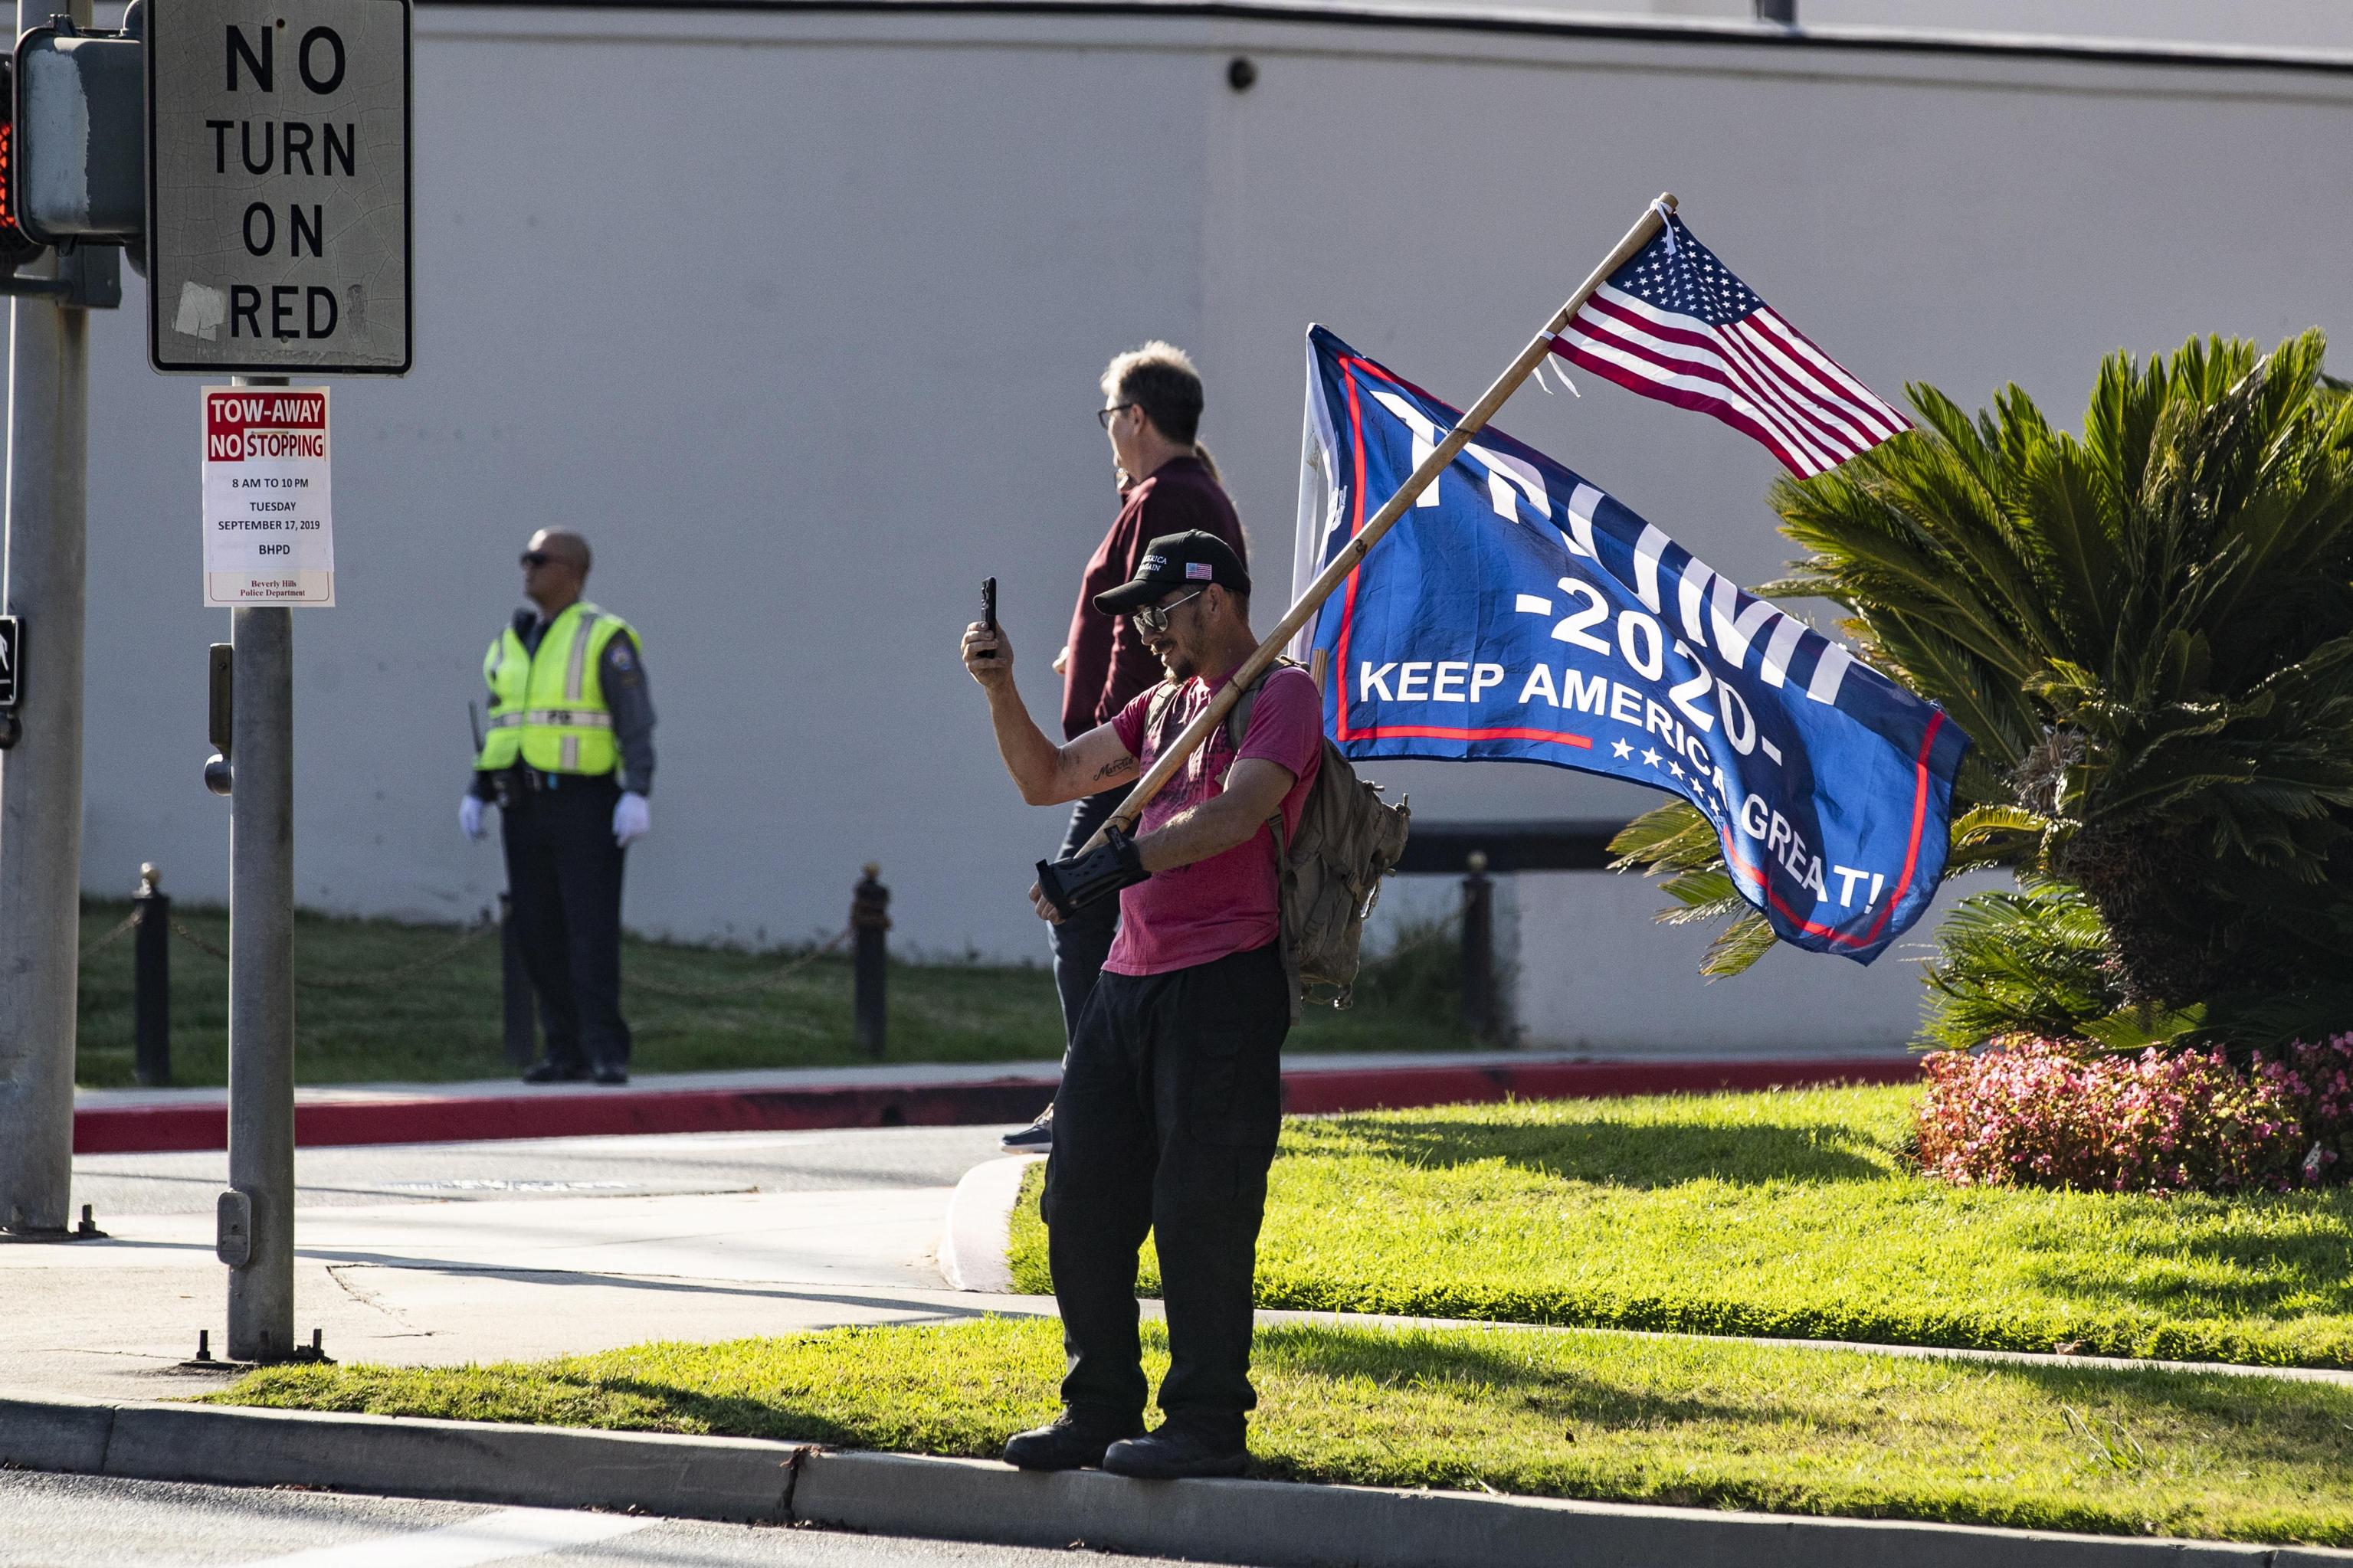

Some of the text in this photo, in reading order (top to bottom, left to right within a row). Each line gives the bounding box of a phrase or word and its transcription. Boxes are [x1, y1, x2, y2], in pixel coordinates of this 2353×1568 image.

[226, 25, 346, 95] NO
[205, 119, 356, 177] TURN
[242, 201, 323, 257] ON
[231, 285, 339, 339] RED
[211, 399, 323, 423] TOW-AWAY
[211, 434, 323, 457] NO STOPPING
[232, 478, 309, 488] 8 AM TO 10 PM
[250, 502, 297, 512] TUESDAY
[218, 520, 320, 532] SEPTEMBER 17, 2019
[258, 545, 290, 555] BHPD
[1369, 389, 1853, 706] TRUM
[1142, 555, 1167, 565] ERICA
[251, 580, 280, 589] Beverly
[266, 589, 306, 598] Department
[1515, 577, 1782, 766] -2020-
[1360, 661, 1885, 914] KEEP AMERICA GREAT!
